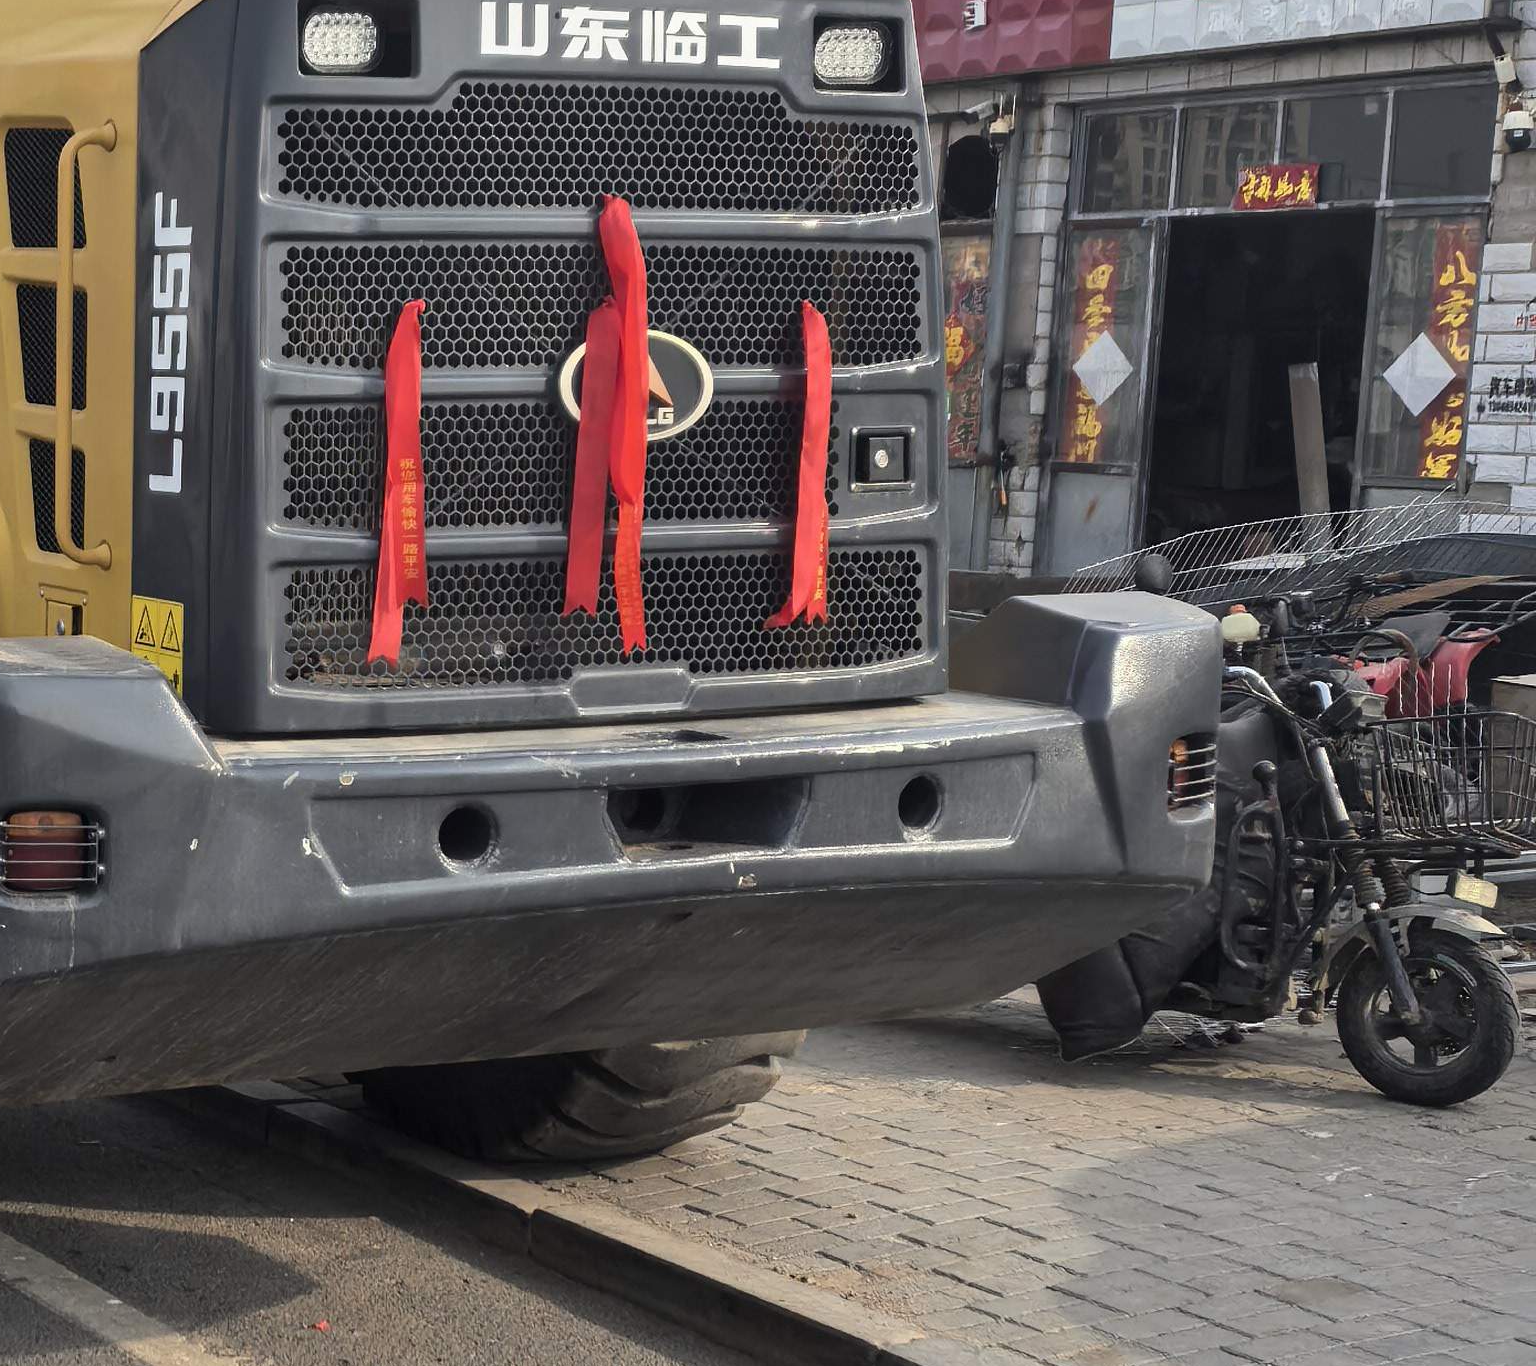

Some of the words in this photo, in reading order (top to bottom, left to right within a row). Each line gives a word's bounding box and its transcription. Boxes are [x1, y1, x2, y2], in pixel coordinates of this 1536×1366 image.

[479, 0, 782, 71] 山东临工
[148, 191, 194, 494] L955F
